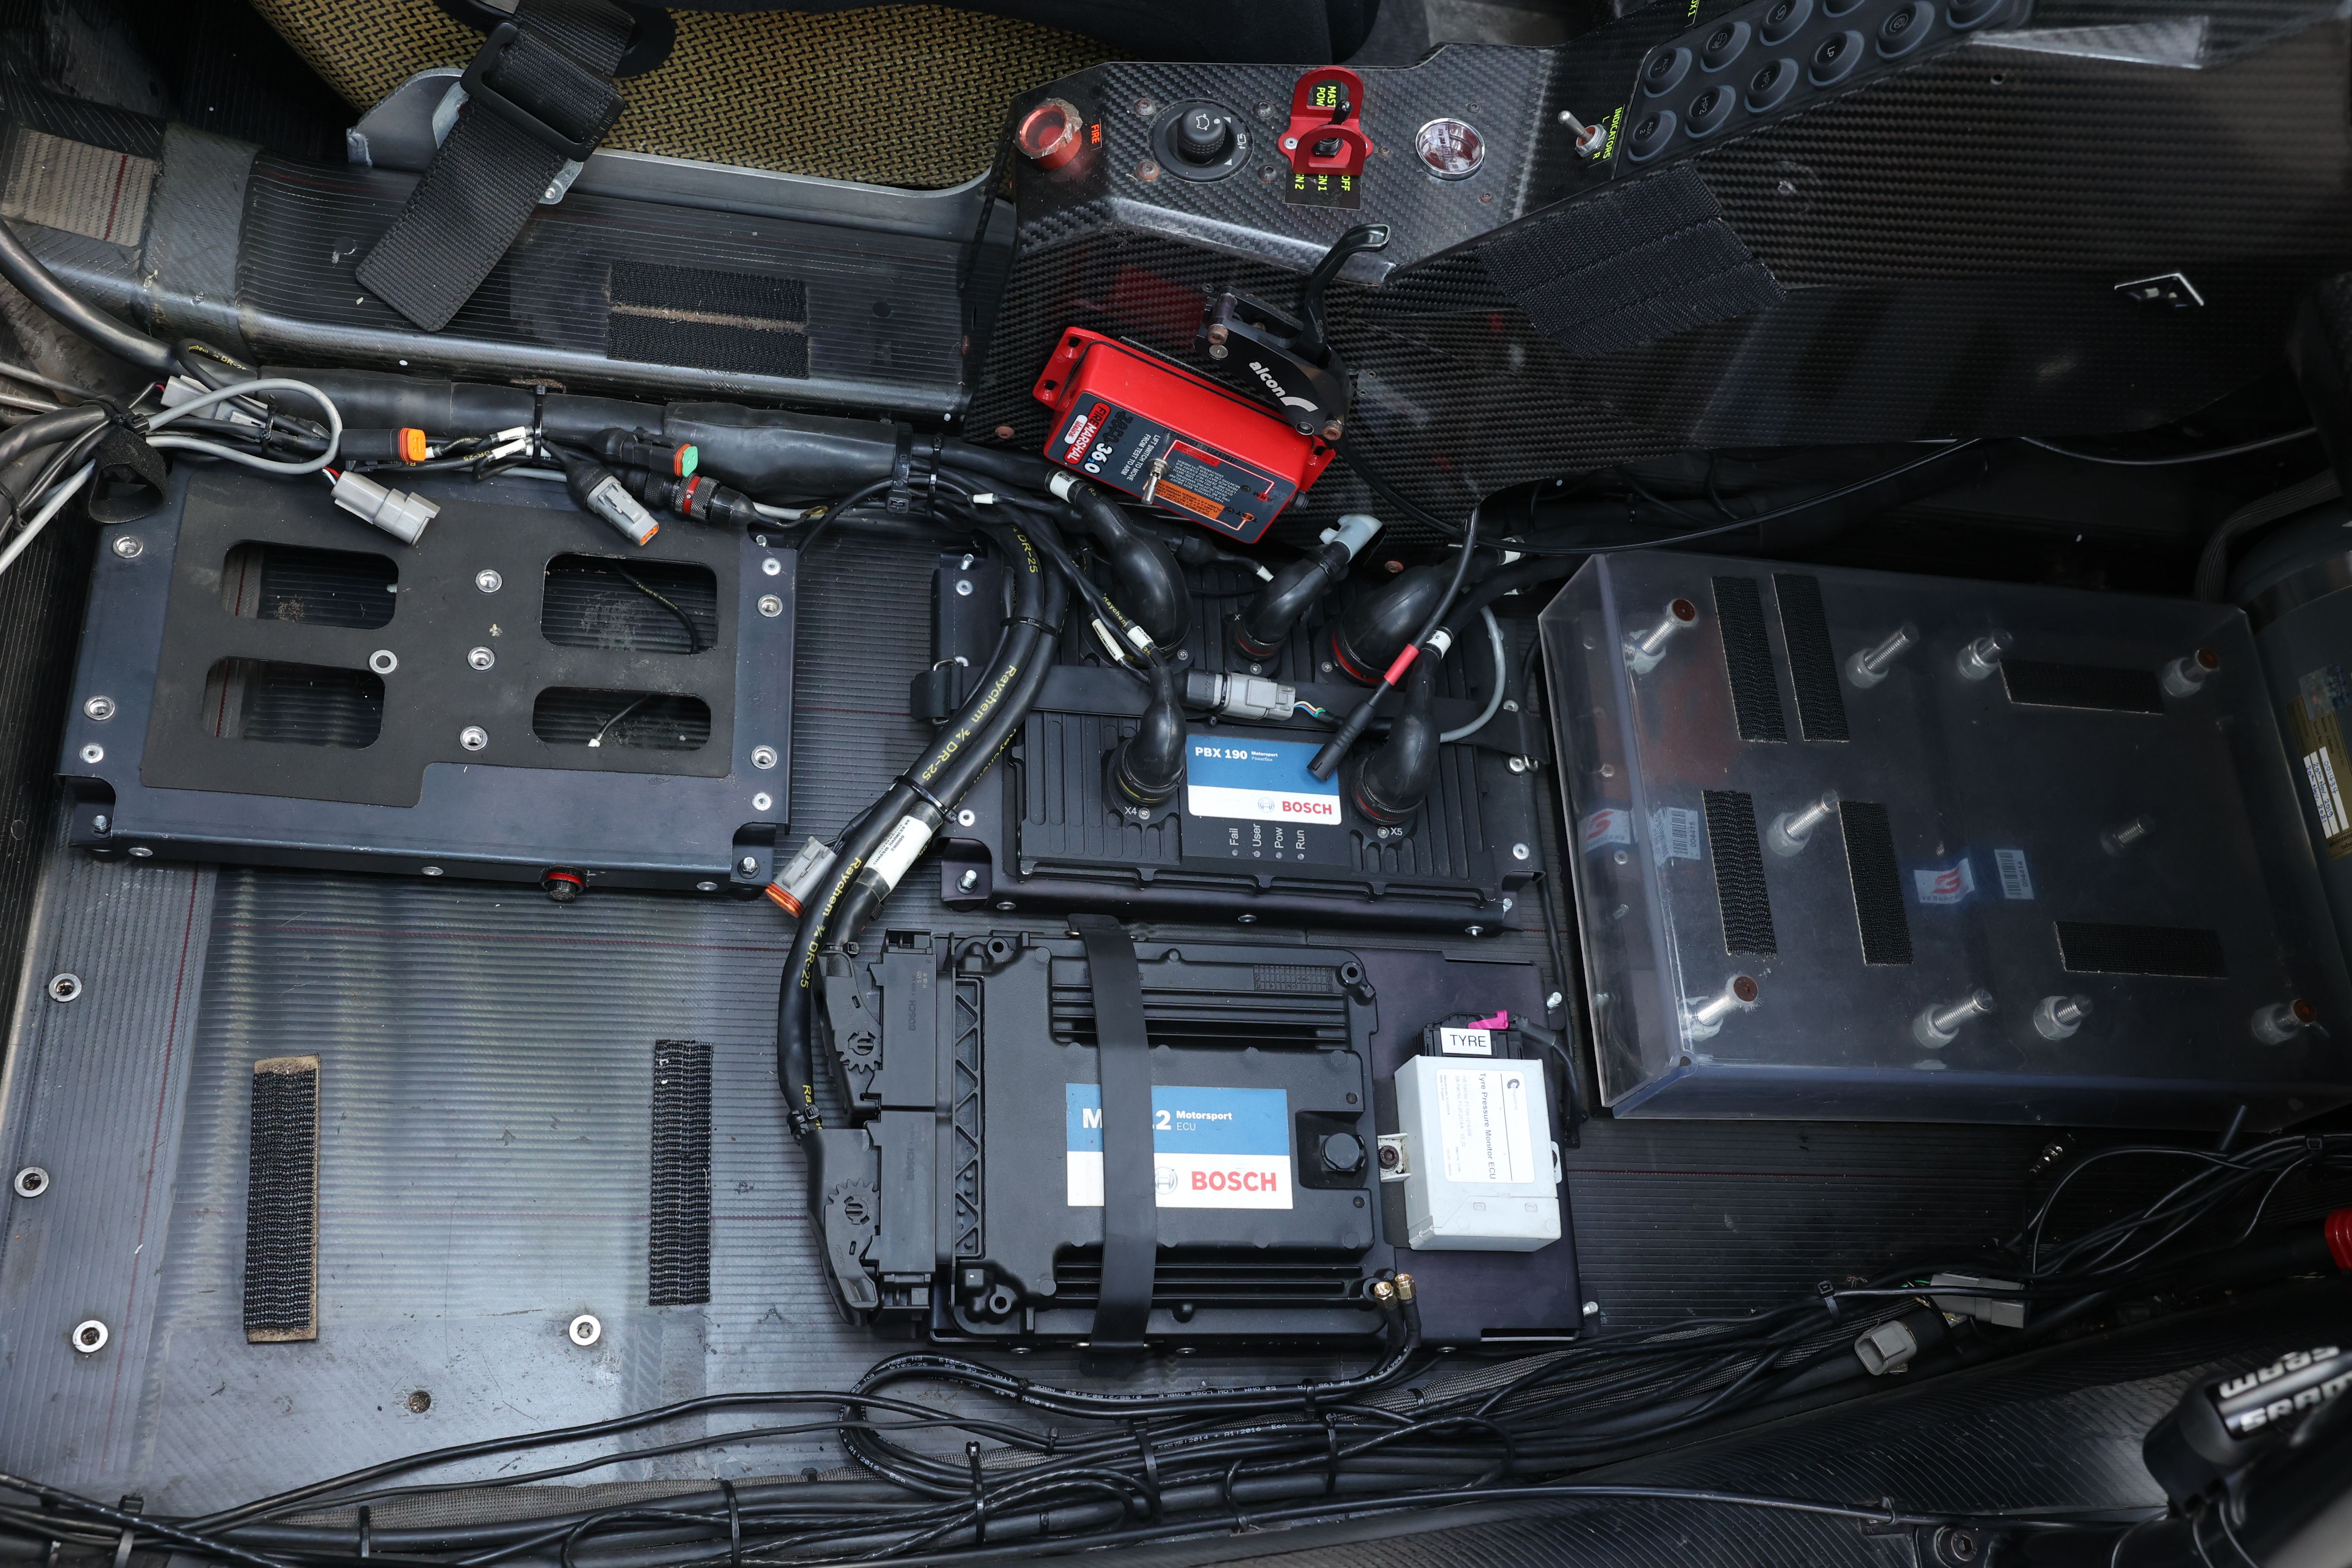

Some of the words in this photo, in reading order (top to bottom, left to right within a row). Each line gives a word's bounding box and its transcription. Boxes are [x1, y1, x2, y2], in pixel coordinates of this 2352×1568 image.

[1825, 44, 1836, 58] LP
[1660, 57, 1669, 74] AUX
[1697, 94, 1711, 116] HP2
[1090, 124, 1101, 144] FIRE
[1602, 105, 1623, 160] INDICATORS
[1644, 120, 1654, 137] AUX
[1341, 175, 1351, 191] OFF
[1248, 356, 1288, 399] alcon
[1068, 420, 1083, 437] lifeline
[1138, 432, 1151, 448] FROM
[1150, 433, 1161, 446] LIFT
[1131, 446, 1142, 459] TEST
[1139, 443, 1154, 463] SWITCH
[1127, 457, 1135, 466] TO
[1134, 460, 1143, 469] TO
[1177, 459, 1199, 471] CYLINDER
[1183, 465, 1197, 474] EVERY
[1120, 464, 1131, 476] ARM
[1127, 467, 1139, 482] MOVE
[1175, 472, 1196, 484] MARSHAL
[1197, 464, 1223, 478] DISCHARGE
[1198, 472, 1217, 483] BATTERY
[1199, 469, 1214, 477] AFTER
[1168, 473, 1187, 484] LIFELINE
[1218, 480, 1238, 492] REPLACE
[1221, 478, 1240, 489] MONTHS
[1193, 487, 1213, 498] CONTROL
[1199, 486, 1212, 494] USED
[1217, 483, 1236, 494] LIFELINE
[1253, 491, 1273, 502] ARM
[1235, 511, 1257, 523] TEST
[1016, 532, 1040, 575] DR-25
[638, 582, 653, 595] DR-25
[658, 594, 678, 610] Raychem
[1100, 595, 1130, 627] Raychem
[1093, 623, 1116, 658] SCRUTINEERING
[968, 664, 1019, 725] Raychem
[920, 738, 959, 784] DR-25
[1195, 747, 1221, 758] PBX
[1225, 749, 1247, 760] 190
[1124, 806, 1137, 816] X4
[1283, 801, 1332, 815] BOSCH
[2317, 804, 2327, 824] 2021
[2323, 798, 2334, 818] 2019
[1229, 827, 1239, 845] Fail
[1253, 824, 1262, 846] User
[1275, 827, 1283, 848] Pow
[1296, 830, 1305, 849] Run
[1390, 827, 1403, 836] X5
[873, 845, 889, 866] CHASSIS
[888, 825, 906, 846] HARNESS
[822, 856, 861, 916] Raychem
[799, 940, 818, 989] DR-25
[907, 1000, 916, 1031] BOSCH
[1449, 1034, 1486, 1048] TYRE
[1478, 1072, 1487, 1090] Tyre
[1176, 1111, 1232, 1120] Motorsport
[1480, 1091, 1491, 1127] Pressure
[1083, 1109, 1102, 1128] M
[1485, 1130, 1494, 1160] Monitor
[906, 1148, 915, 1180] BOSCH
[1488, 1161, 1496, 1179] ECU
[1192, 1172, 1277, 1191] BOSCH
[986, 1372, 1013, 1382] ITALY
[1224, 1426, 1261, 1437] A1:2016
[847, 1446, 880, 1471] A1:2016
[889, 1473, 906, 1483] Eca
